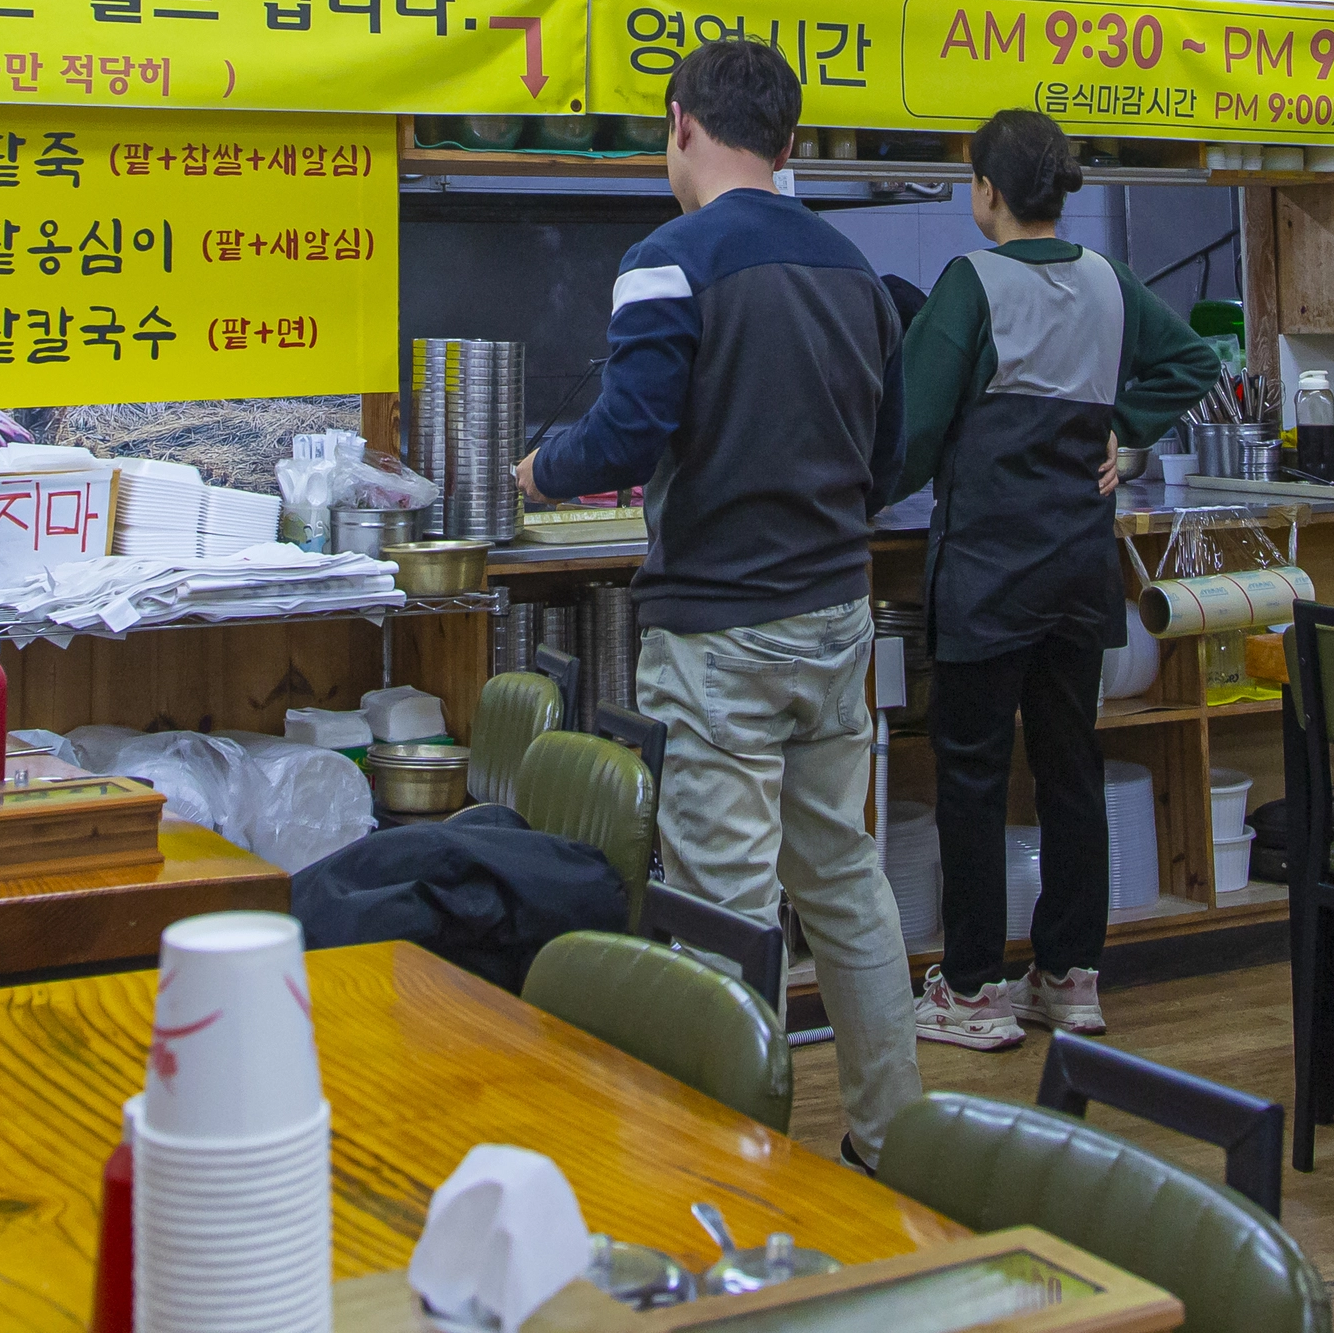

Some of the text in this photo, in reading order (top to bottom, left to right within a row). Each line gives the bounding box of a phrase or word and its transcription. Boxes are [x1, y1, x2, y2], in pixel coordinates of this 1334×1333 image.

[940, 9, 1025, 62] AM
[1045, 10, 1163, 69] 9:30
[1224, 27, 1294, 77] PM
[60, 55, 170, 96] 적당히
[1031, 82, 1197, 122] (음식마감시간
[1215, 92, 1258, 121] PM
[110, 143, 371, 177] (팥+찹쌀+새알심)
[203, 228, 373, 262] (팥+새알심)
[209, 316, 317, 351] (팥+면)
